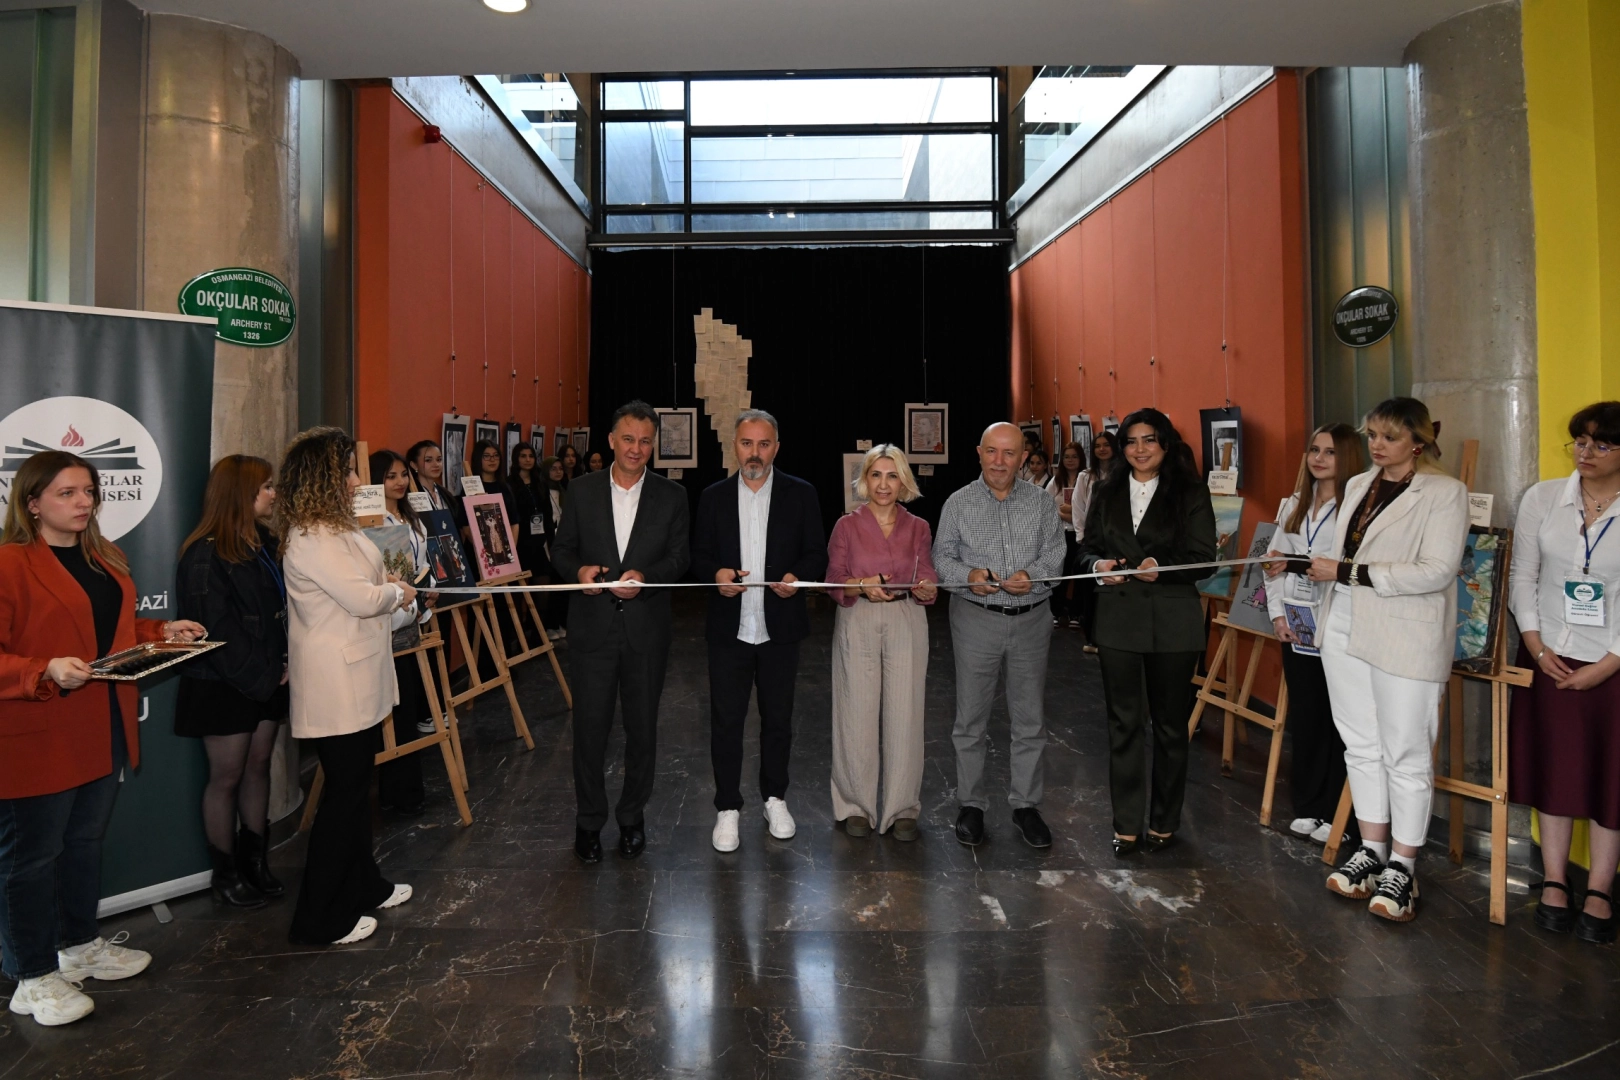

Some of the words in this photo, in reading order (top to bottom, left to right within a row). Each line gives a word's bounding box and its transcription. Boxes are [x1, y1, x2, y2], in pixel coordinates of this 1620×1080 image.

[211, 273, 253, 284] OSMANGAZİ
[196, 290, 258, 311] OKÇULAR
[261, 297, 290, 317] SOKAK
[1336, 308, 1363, 326] OKÇULAR
[1364, 303, 1388, 319] SOKAK
[230, 318, 262, 330] ARCHERY
[243, 331, 260, 340] 1326
[98, 473, 143, 486] ĞLAR
[101, 487, 142, 502] İSESİ
